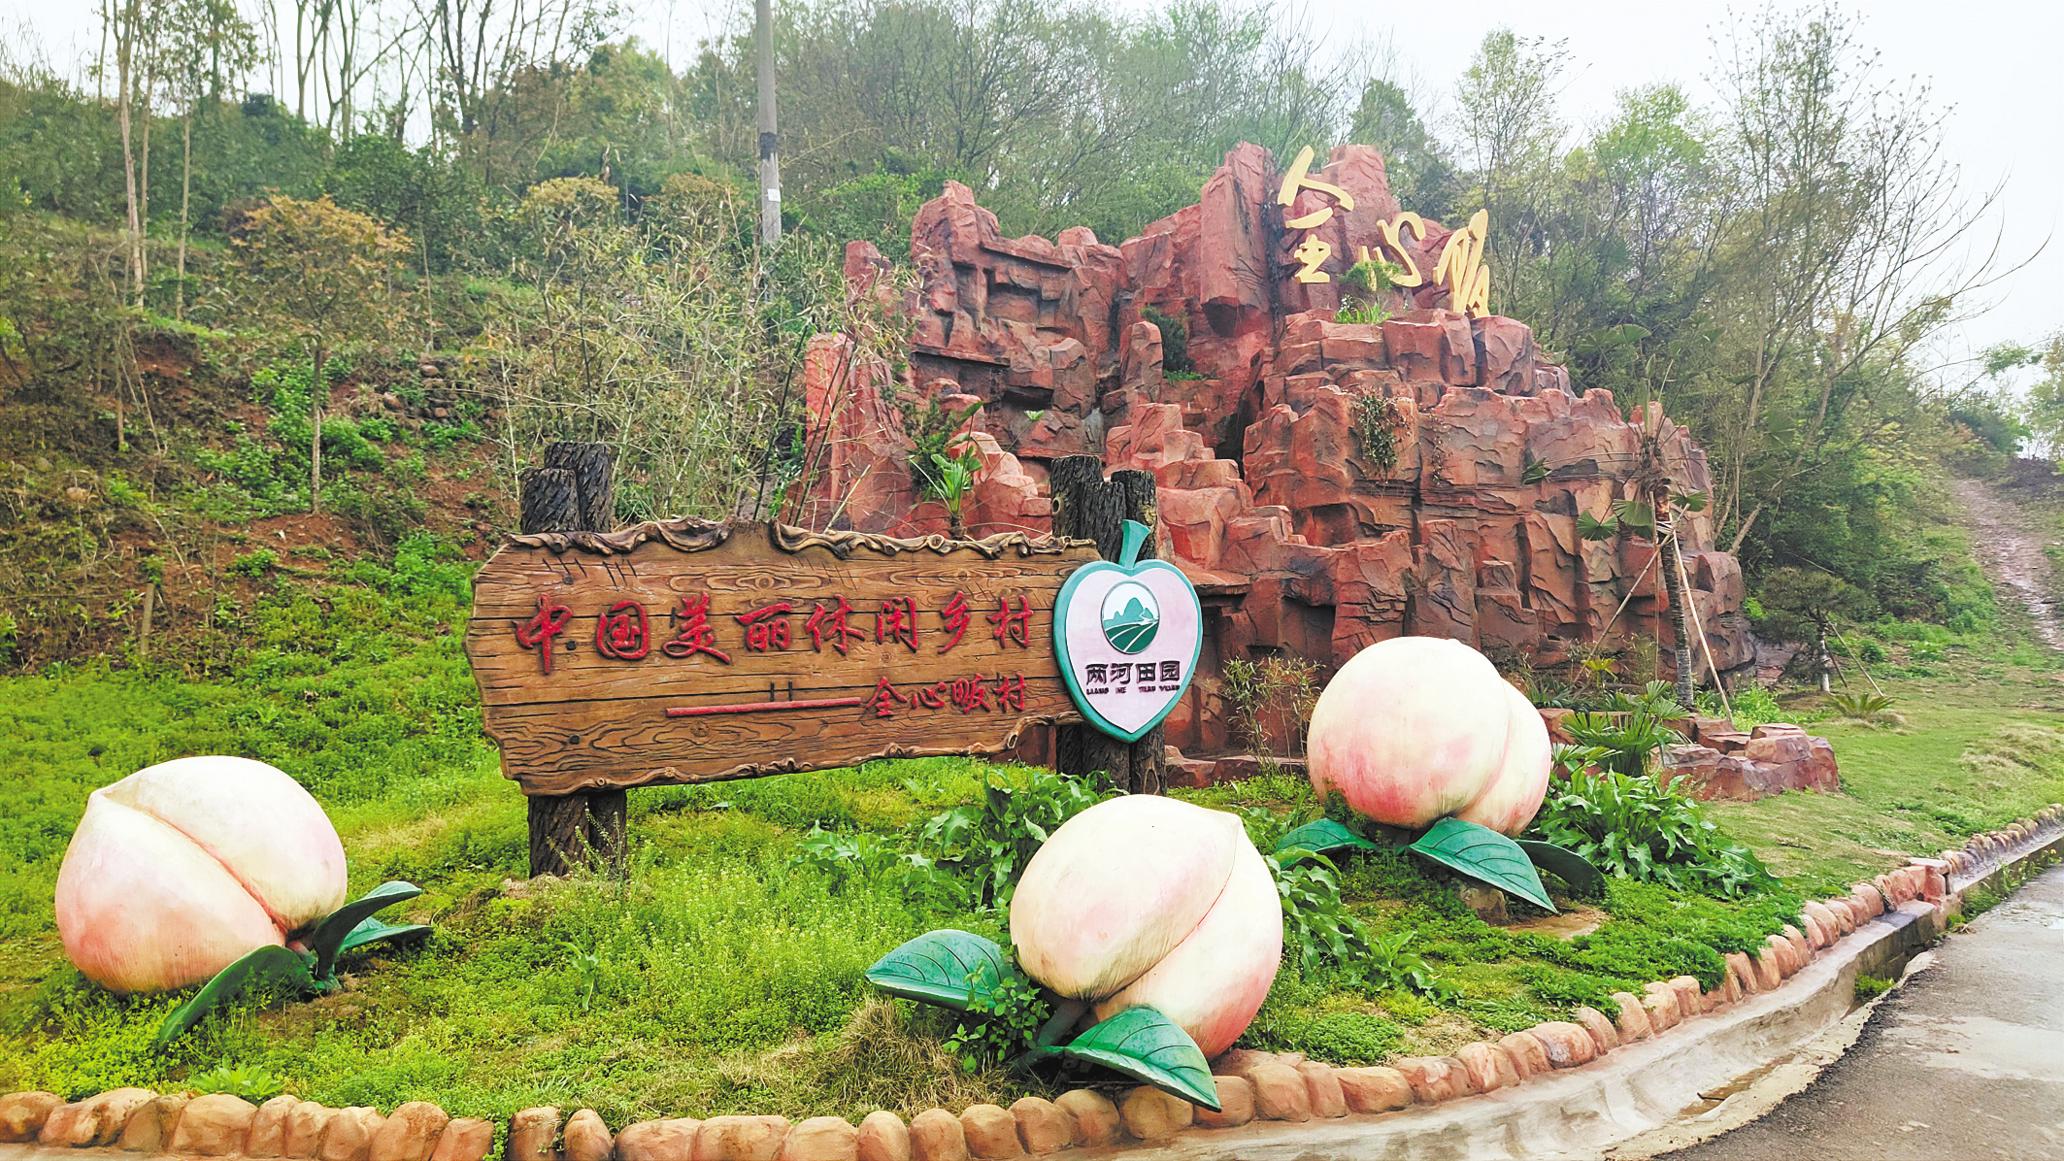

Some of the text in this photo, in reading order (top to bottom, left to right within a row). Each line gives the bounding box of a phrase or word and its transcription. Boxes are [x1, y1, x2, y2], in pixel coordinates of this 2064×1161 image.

[511, 591, 1034, 676] 中国美丽休闲乡村
[864, 671, 1026, 718] 全心畈村
[1085, 660, 1181, 685] 两河田园
